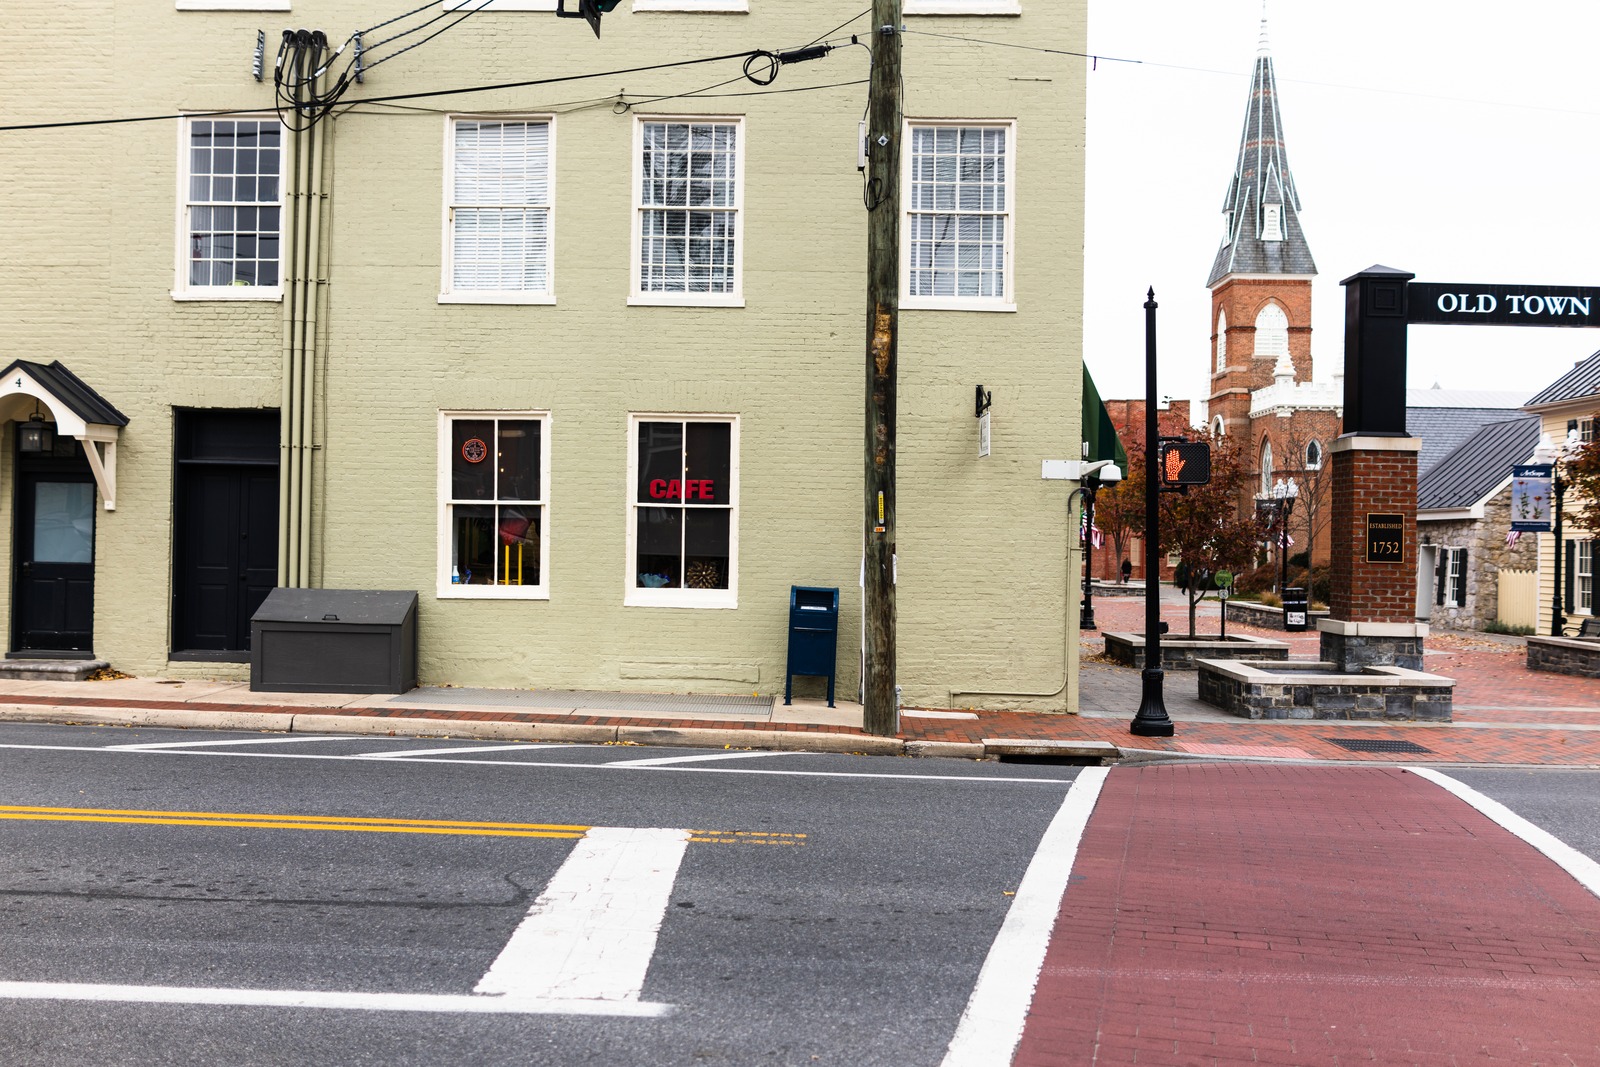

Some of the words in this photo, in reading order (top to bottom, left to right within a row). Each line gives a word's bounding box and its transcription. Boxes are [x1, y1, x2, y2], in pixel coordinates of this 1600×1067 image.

[1437, 293, 1497, 313] OLD
[1505, 294, 1591, 316] TOWN
[15, 378, 21, 387] 4
[649, 478, 714, 499] CAFE
[1373, 542, 1399, 554] 1752
